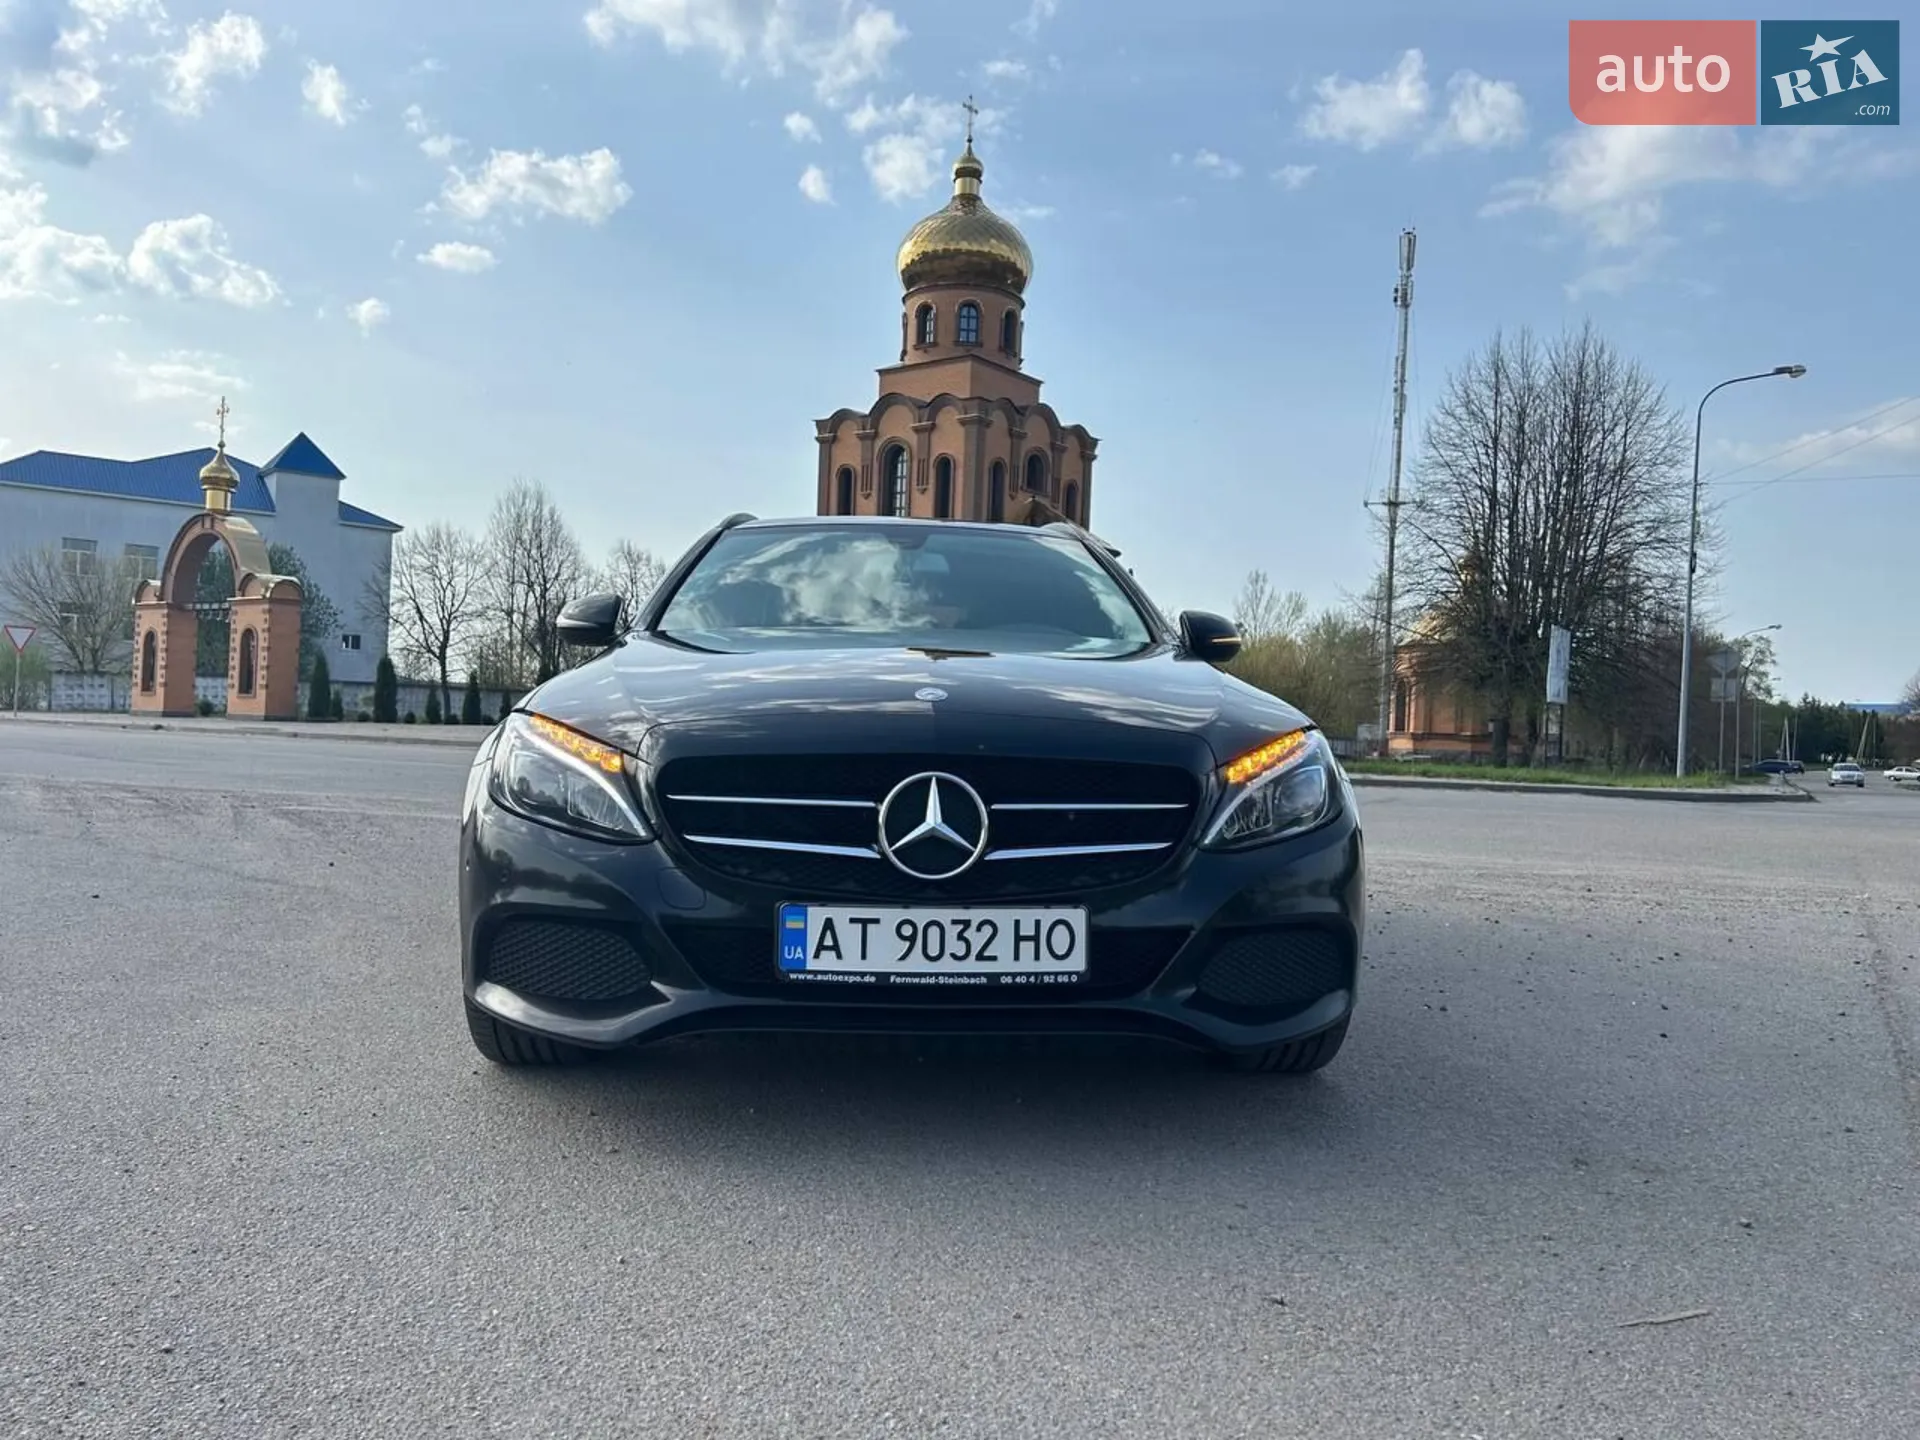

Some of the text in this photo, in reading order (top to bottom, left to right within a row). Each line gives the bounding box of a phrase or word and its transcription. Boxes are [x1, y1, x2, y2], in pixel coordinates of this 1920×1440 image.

[812, 916, 1077, 963] AT 9032 HO
[784, 945, 805, 960] UA
[788, 972, 877, 984] www.autoexpo.de
[889, 974, 988, 985] Fernwald-Steinbach
